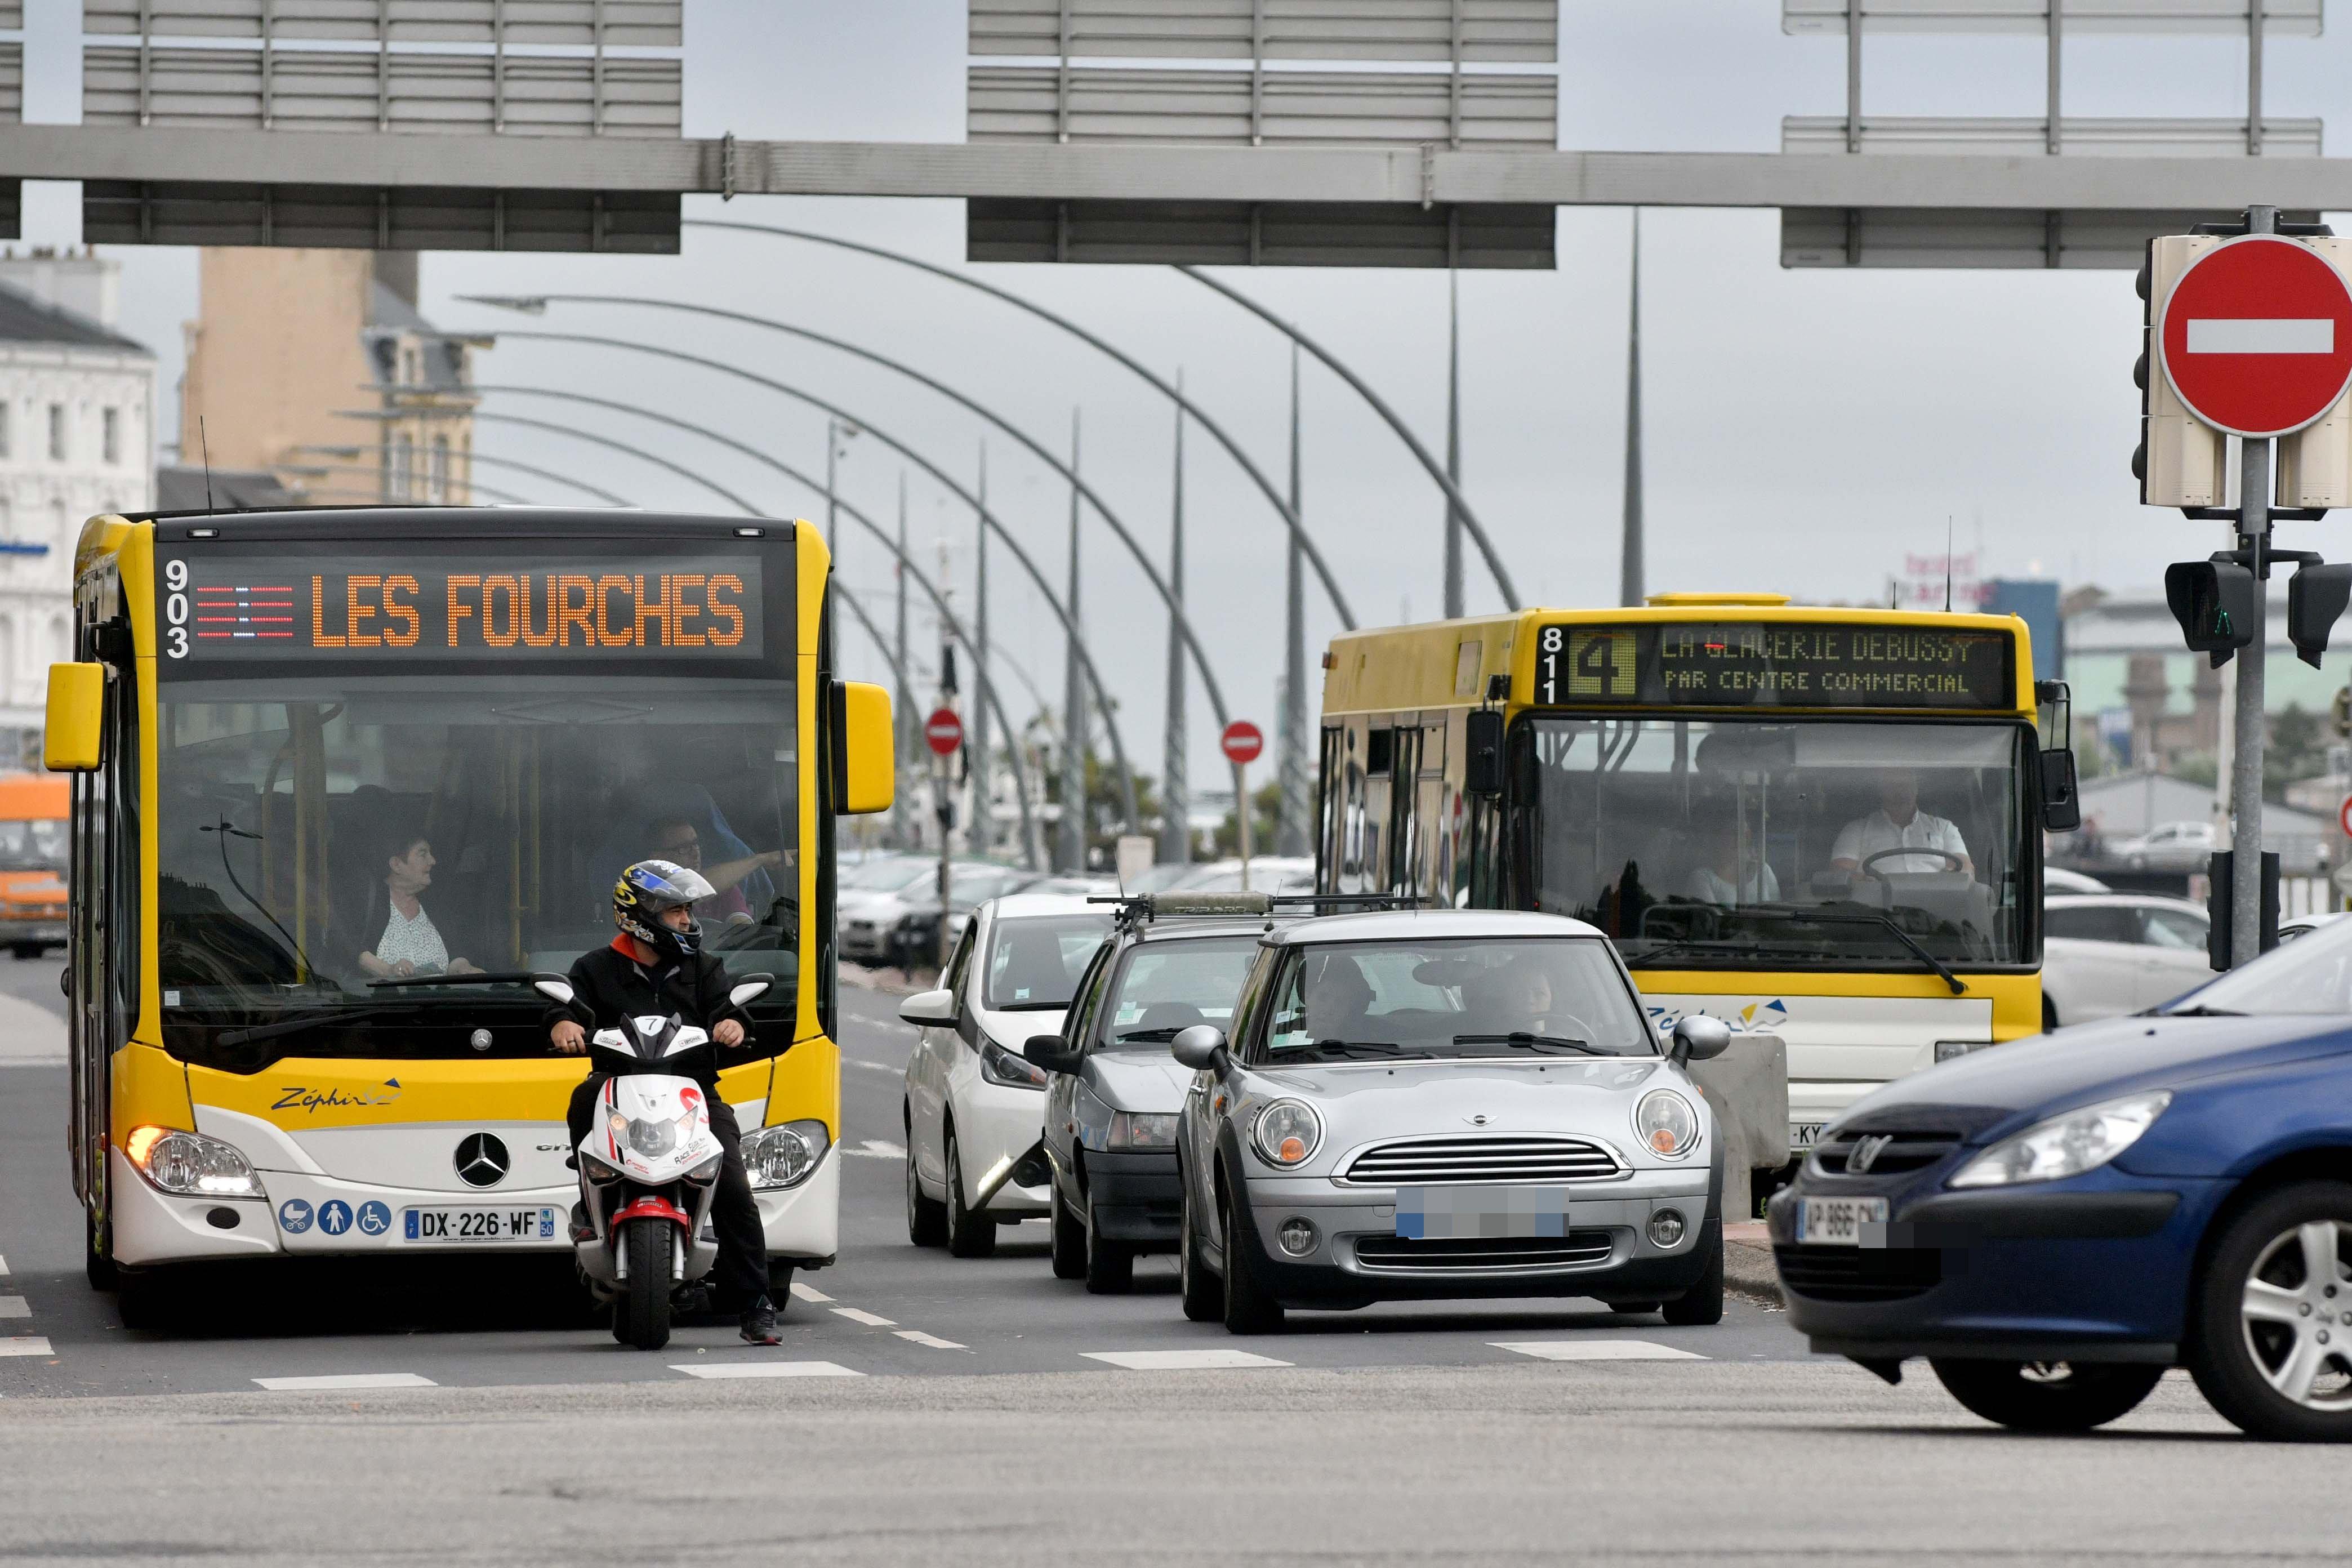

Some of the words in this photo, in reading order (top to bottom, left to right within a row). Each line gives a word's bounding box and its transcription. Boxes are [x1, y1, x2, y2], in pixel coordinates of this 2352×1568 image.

[166, 559, 189, 659] 903
[313, 575, 419, 647] LES
[448, 574, 743, 647] FOURCHES
[1662, 630, 1694, 658] LA
[1853, 631, 1972, 662] DEBUSSY
[1543, 627, 1563, 704] 811
[1665, 670, 1707, 688] PAR
[1720, 671, 1809, 690] CENTRE
[1822, 672, 1968, 692] COMMERCIAL
[644, 1018, 658, 1031] 7
[271, 1088, 368, 1113] Zéphir
[422, 1211, 536, 1236] DX-226-WF
[541, 1224, 553, 1235] 50
